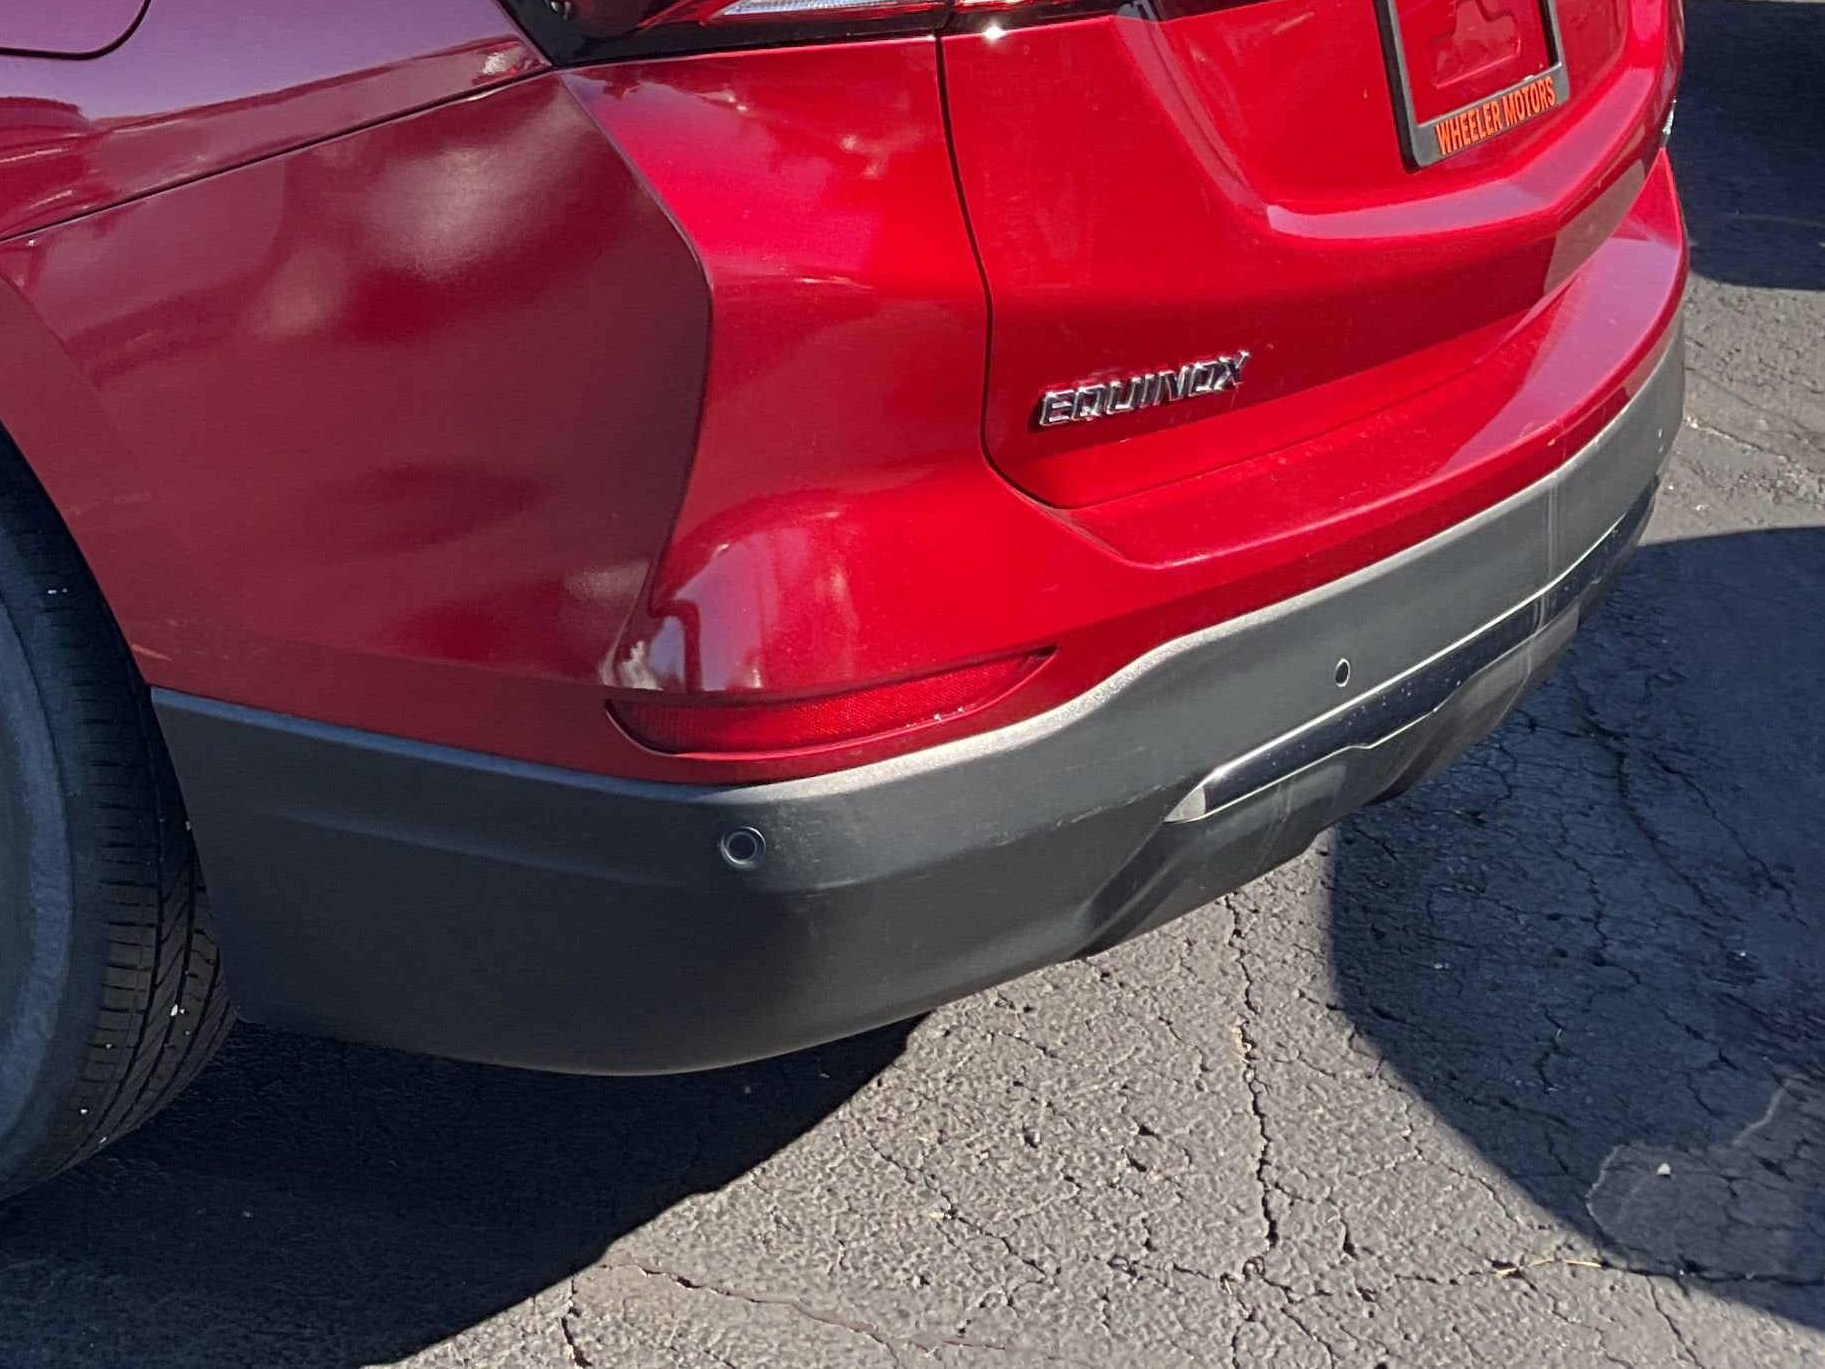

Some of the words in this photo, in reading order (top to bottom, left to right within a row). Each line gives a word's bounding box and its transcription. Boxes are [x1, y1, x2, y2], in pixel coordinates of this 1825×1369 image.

[1435, 100, 1504, 156] WHEELER
[1501, 75, 1557, 127] MOTORS
[1039, 349, 1251, 427] EQUINOX
